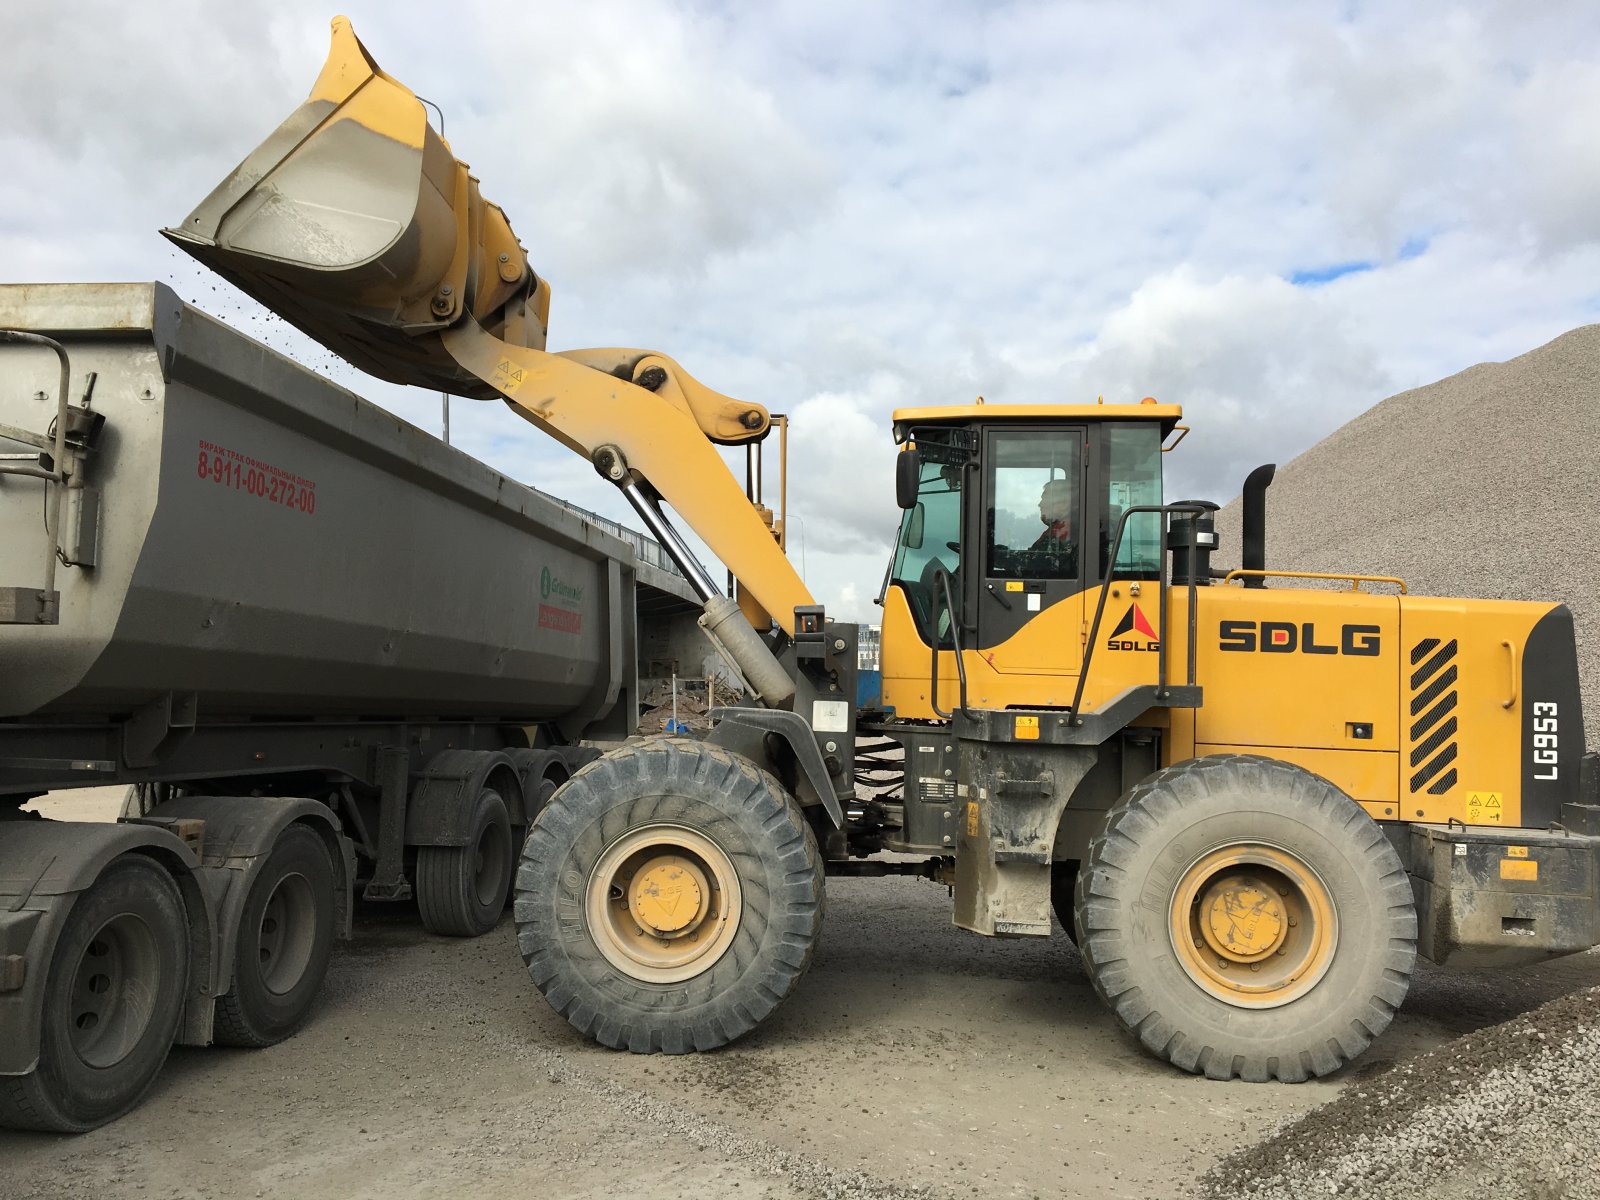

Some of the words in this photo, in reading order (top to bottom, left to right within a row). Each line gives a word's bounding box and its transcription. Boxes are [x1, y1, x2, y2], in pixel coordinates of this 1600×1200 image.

[199, 440, 225, 457] ВИРАЖ
[227, 449, 245, 464] ТРАК
[198, 451, 316, 515] 8-911-00-272-00
[1107, 640, 1160, 652] SDLG
[1219, 620, 1380, 657] SDLG
[1533, 702, 1558, 780] LG953
[559, 870, 585, 943] HILO
